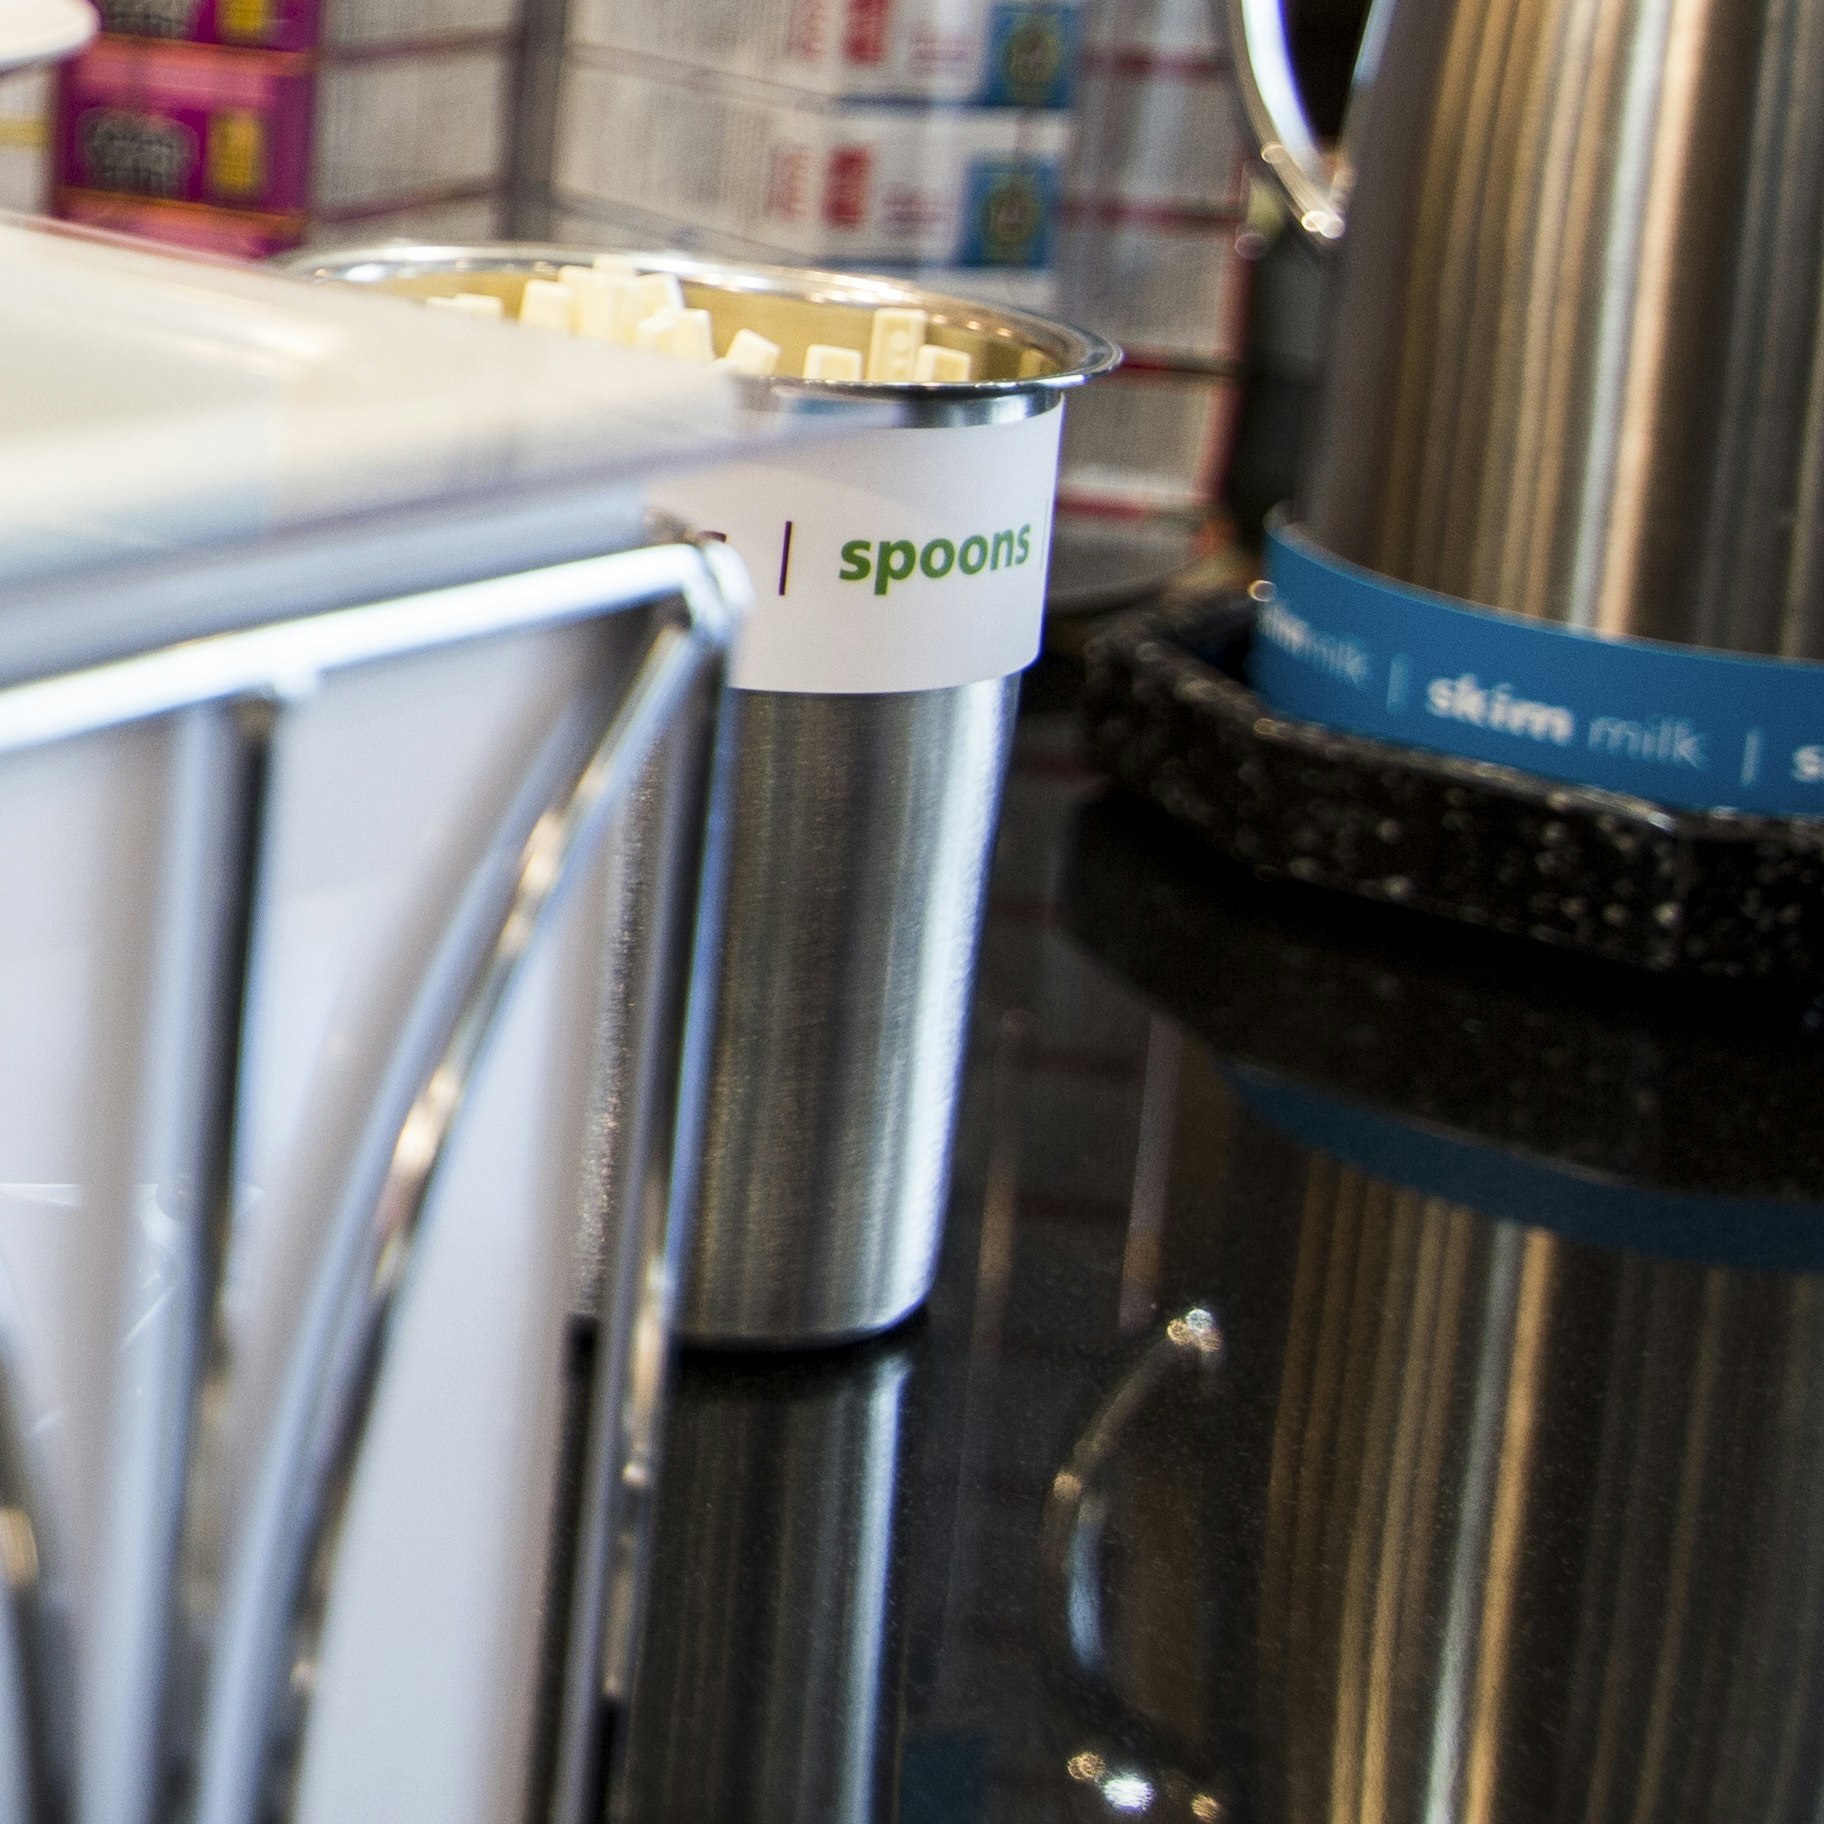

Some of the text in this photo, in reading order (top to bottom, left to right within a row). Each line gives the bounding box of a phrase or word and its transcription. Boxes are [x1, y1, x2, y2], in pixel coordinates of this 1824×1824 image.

[838, 523, 1031, 597] spoons
[1425, 673, 1576, 748] skim
[1588, 713, 1707, 774] milk
